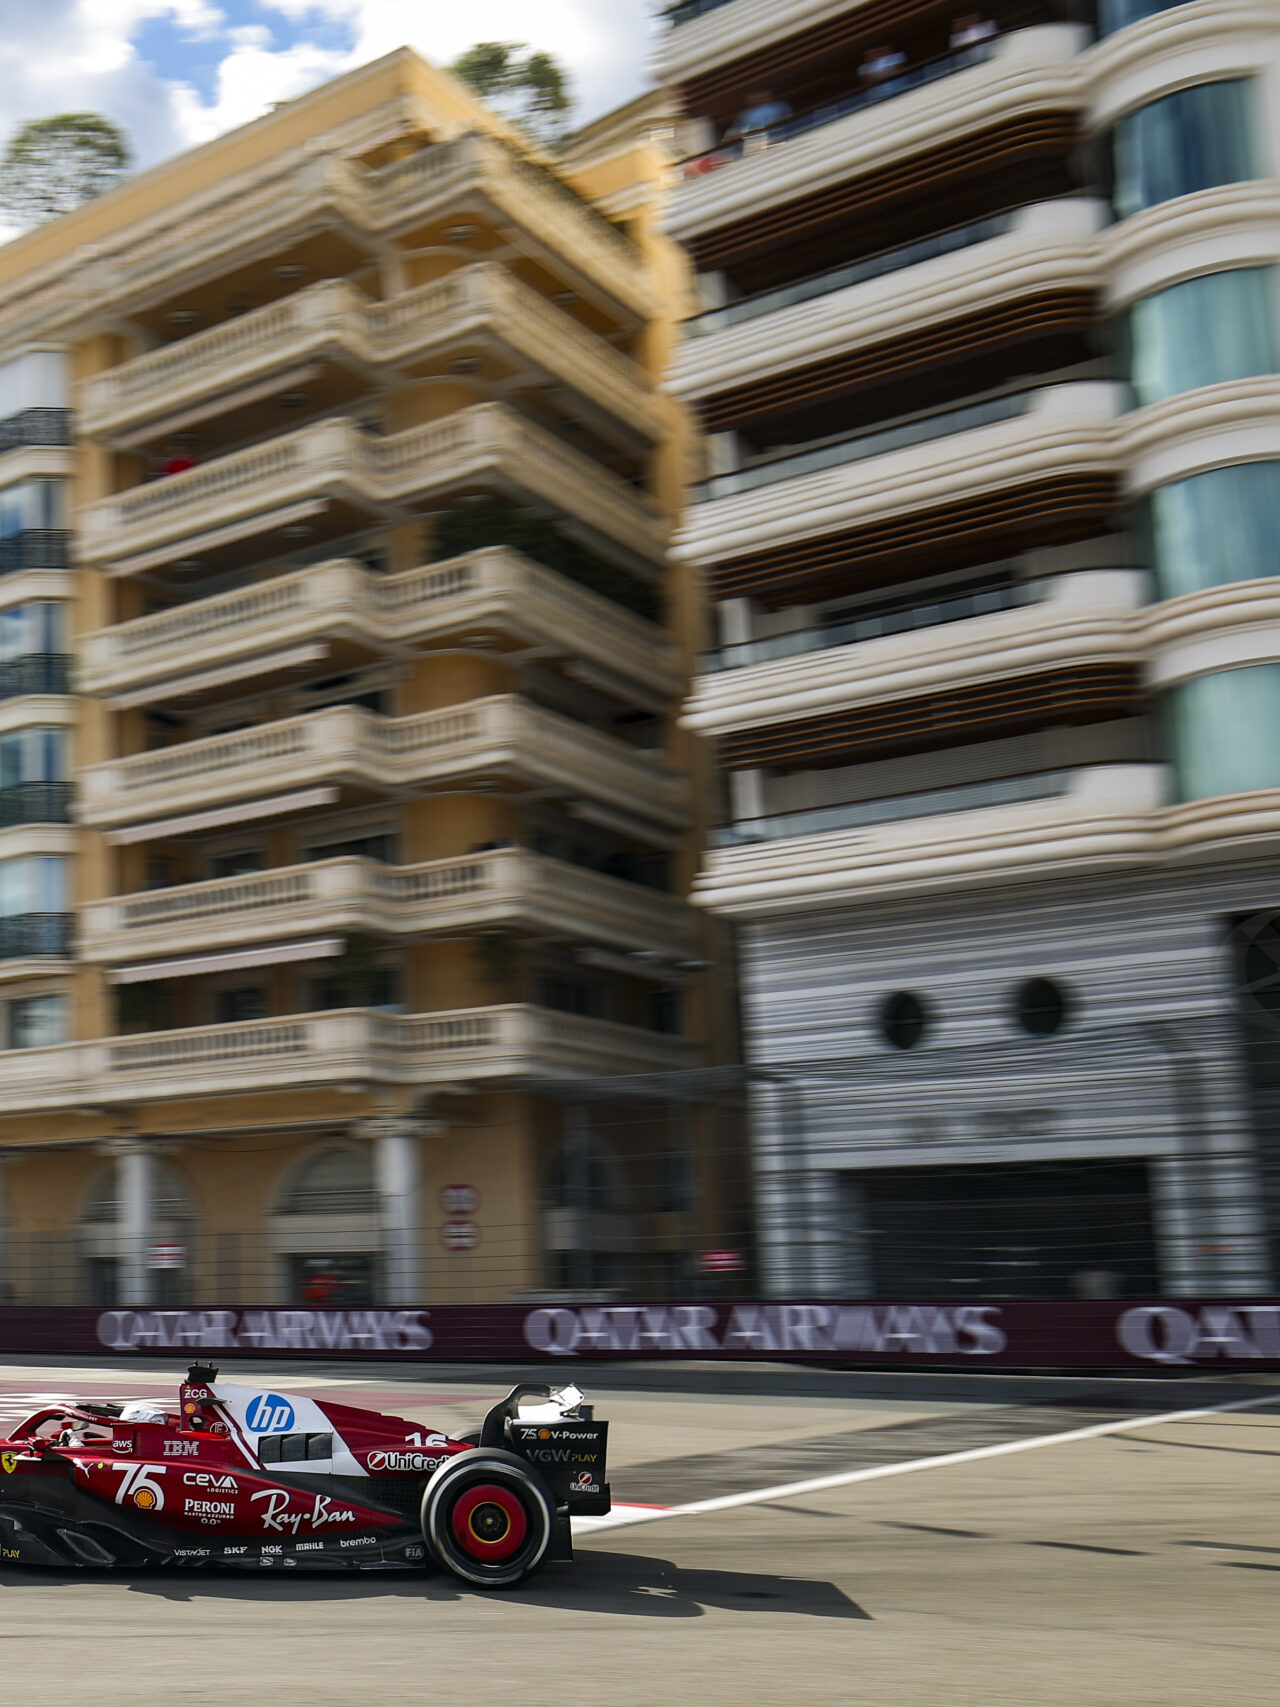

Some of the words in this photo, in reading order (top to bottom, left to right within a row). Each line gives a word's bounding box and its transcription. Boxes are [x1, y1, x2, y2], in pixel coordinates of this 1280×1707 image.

[96, 1310, 239, 1350] QATAR
[523, 1305, 723, 1356] QATAR
[723, 1304, 1009, 1355] AIRWAYS
[184, 1389, 207, 1399] ZCG
[251, 1394, 291, 1432] hp
[550, 1430, 599, 1439] V-Power
[113, 1440, 132, 1448] aws
[163, 1441, 199, 1456] IBM
[386, 1451, 451, 1470] UniCred
[526, 1449, 572, 1462] VGW
[571, 1454, 597, 1462] PLAY
[112, 1462, 167, 1511] 75
[184, 1498, 235, 1514] PERONI
[296, 1542, 324, 1551] MAHLE
[340, 1536, 376, 1548] brembo
[2, 1548, 20, 1558] PLAY
[224, 1546, 248, 1554] SKF
[261, 1545, 283, 1553] NGK
[406, 1548, 422, 1557] FIA
